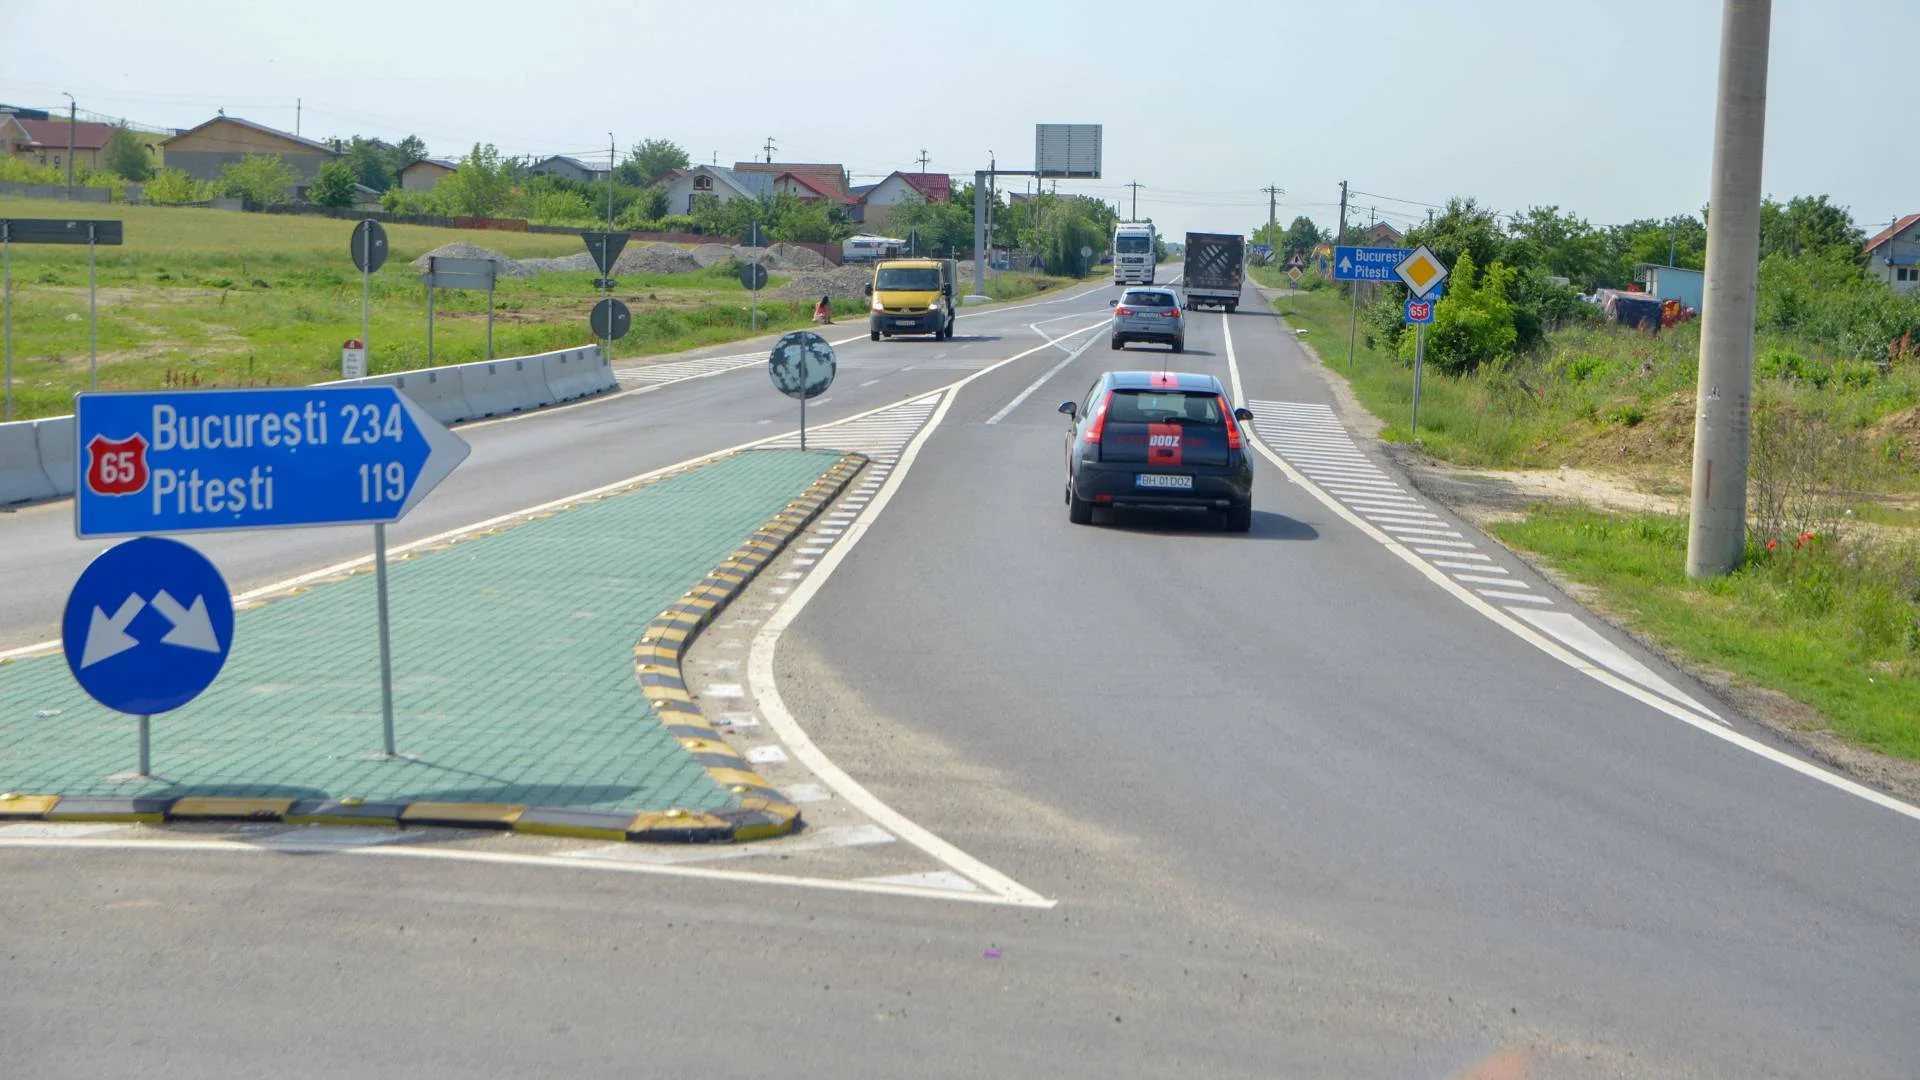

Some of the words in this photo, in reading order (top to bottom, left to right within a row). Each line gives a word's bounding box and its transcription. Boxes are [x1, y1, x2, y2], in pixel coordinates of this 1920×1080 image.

[153, 402, 328, 453] București
[340, 404, 404, 445] 234
[98, 451, 135, 484] 65
[153, 466, 273, 519] Pitești
[359, 461, 405, 503] 119
